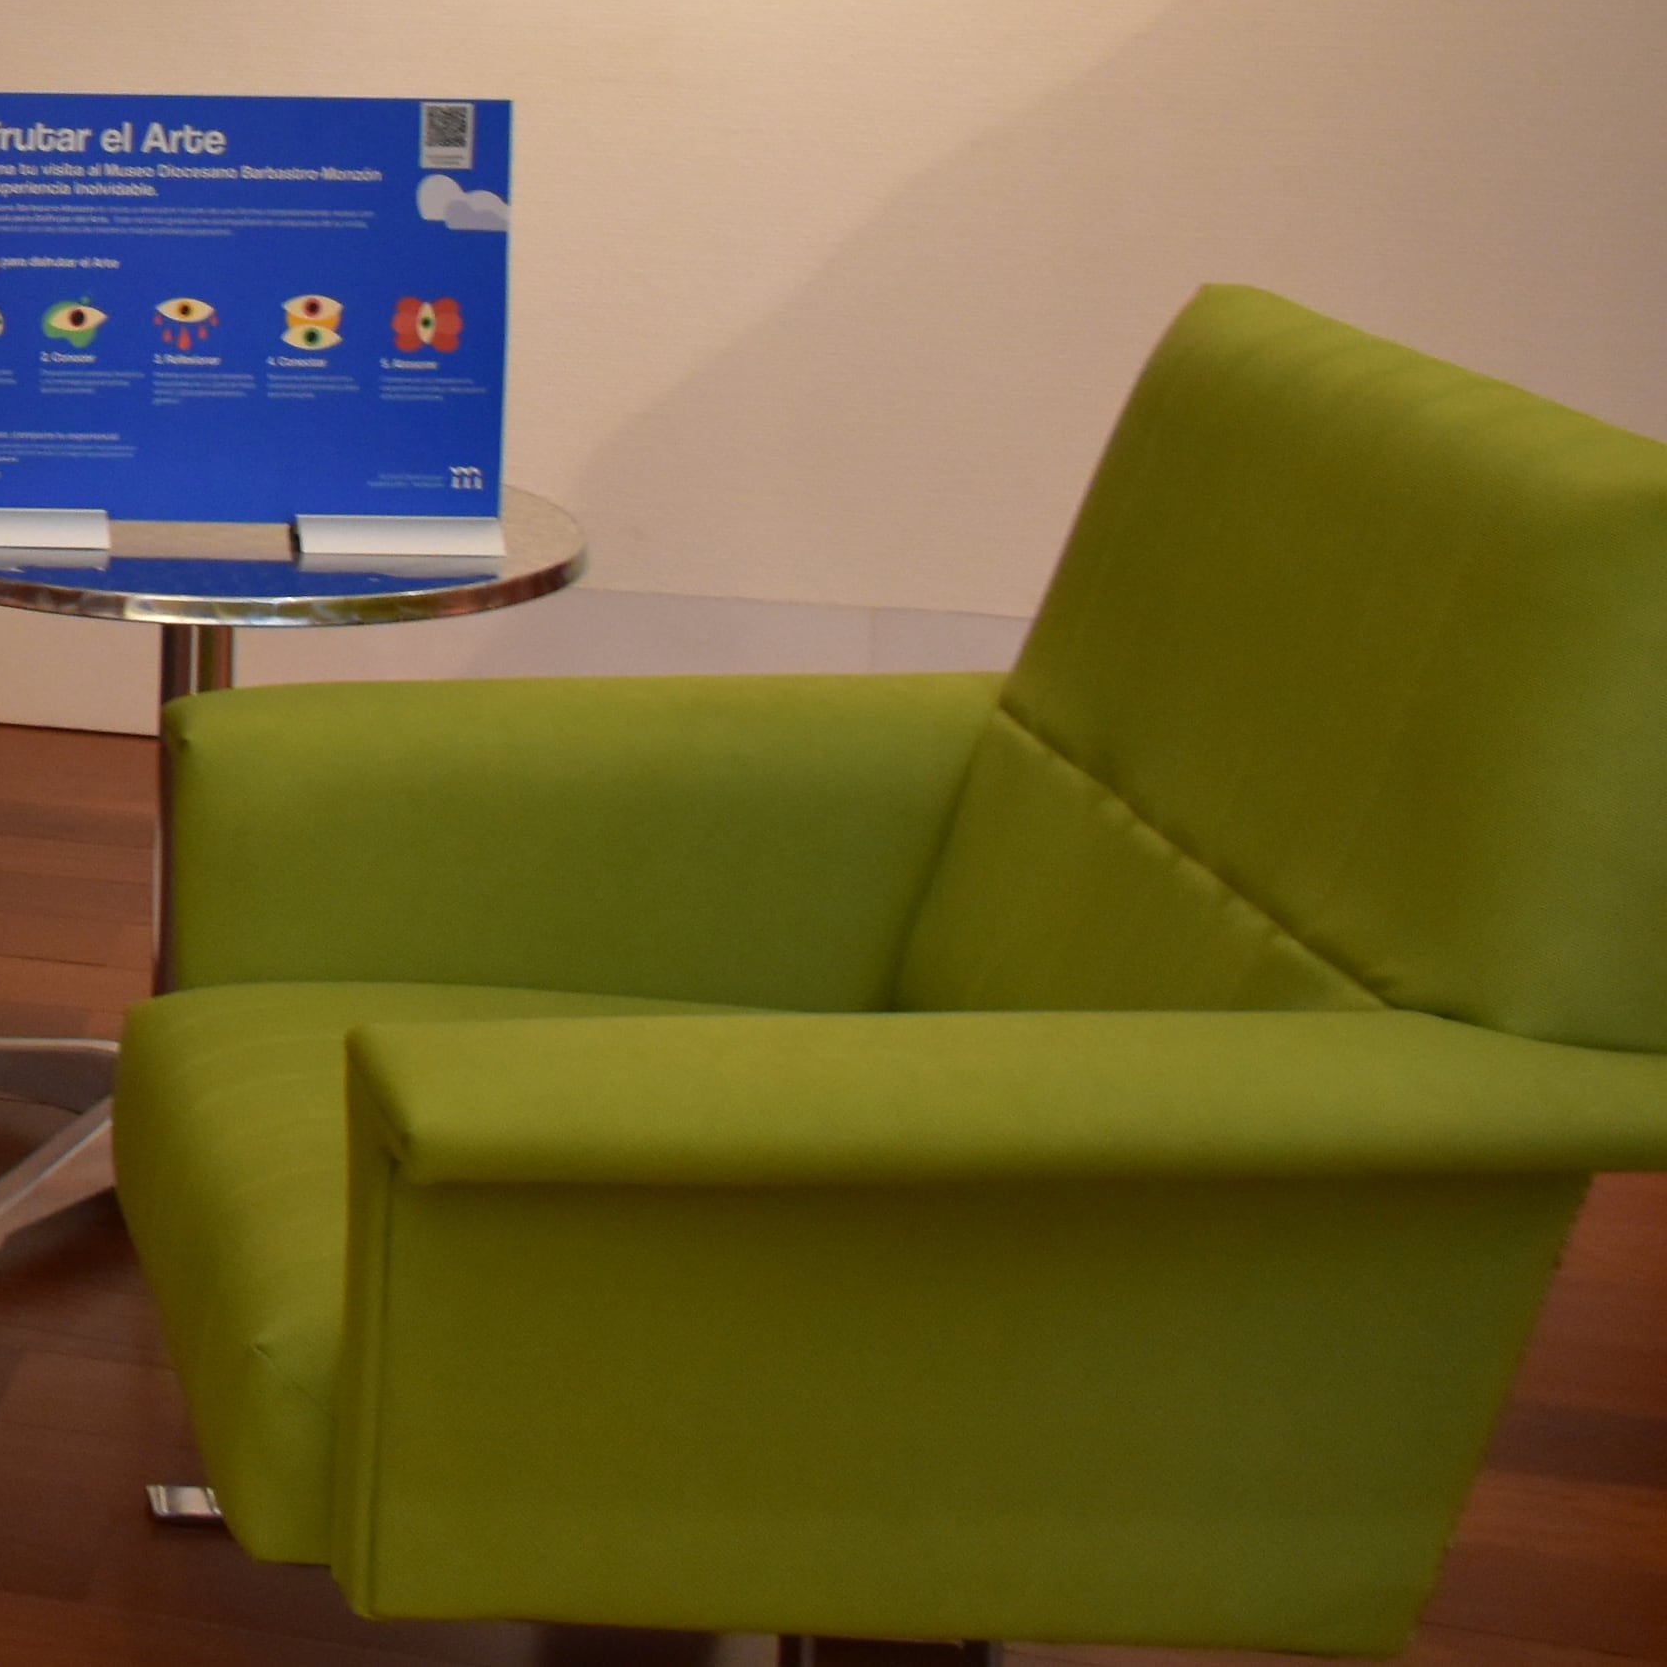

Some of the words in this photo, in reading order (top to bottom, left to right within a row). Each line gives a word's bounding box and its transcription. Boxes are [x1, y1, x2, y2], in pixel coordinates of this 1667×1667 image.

[100, 122, 133, 153] el
[140, 122, 227, 155] Arte
[18, 163, 39, 176] tu
[41, 163, 85, 177] visita
[87, 163, 102, 177] al
[104, 163, 155, 177] Museo
[156, 164, 238, 179] Diocesano
[240, 165, 383, 181] Barbastro-Monzón
[74, 181, 159, 196] inolvidable.
